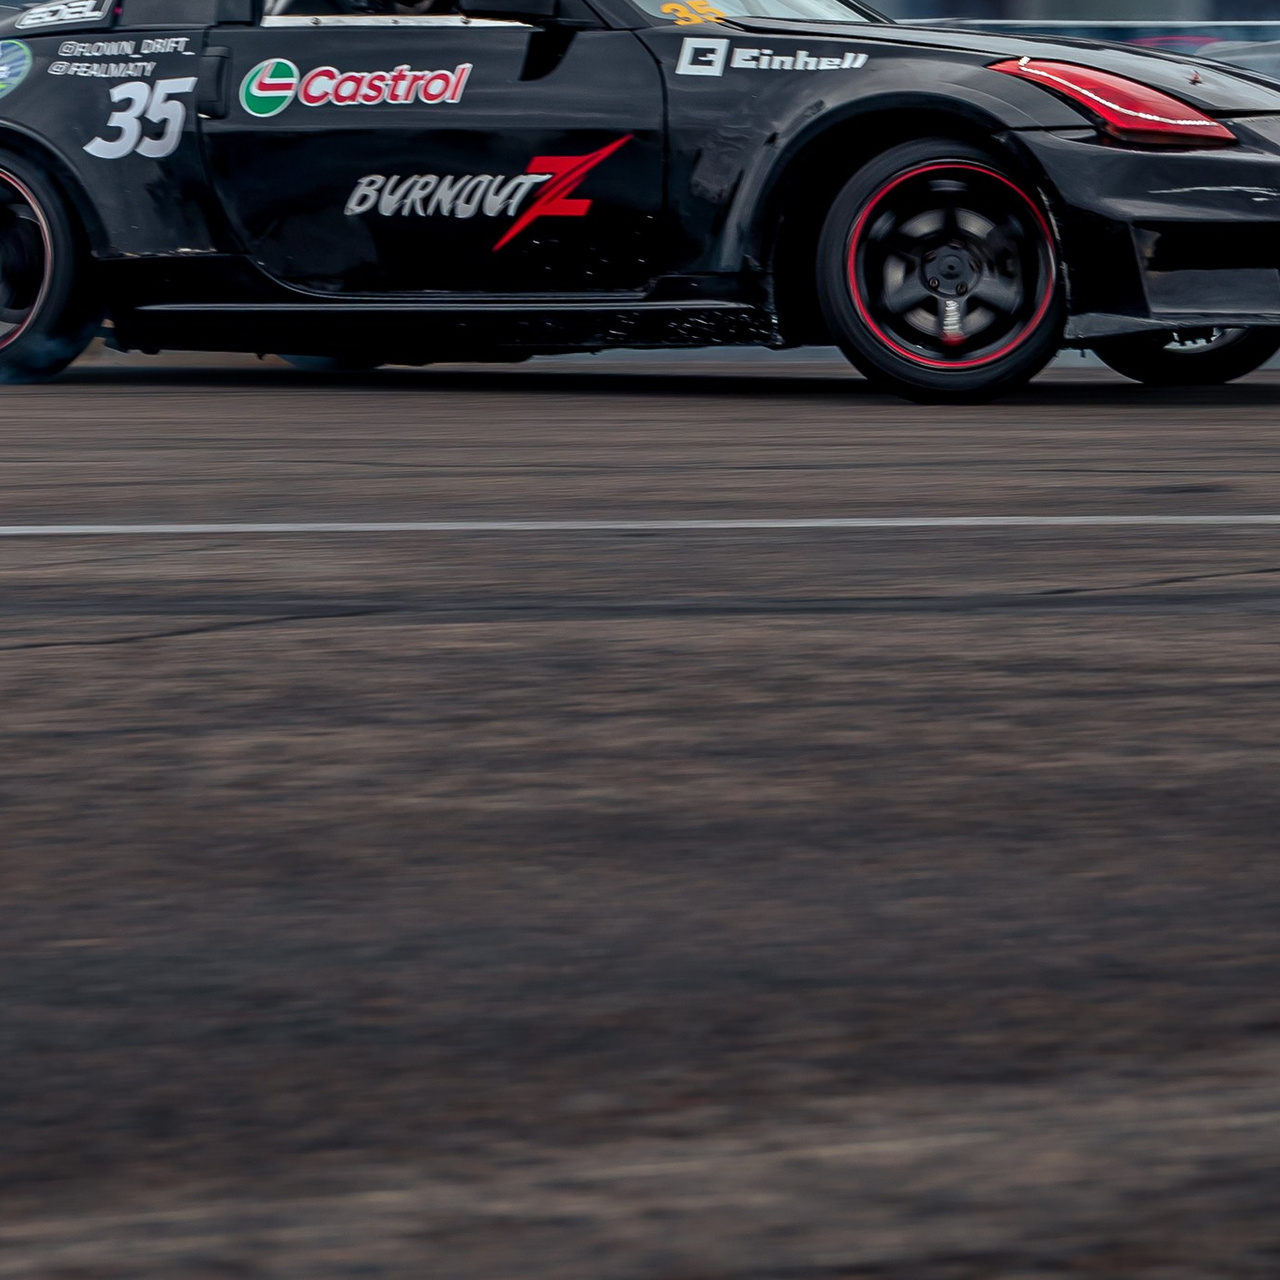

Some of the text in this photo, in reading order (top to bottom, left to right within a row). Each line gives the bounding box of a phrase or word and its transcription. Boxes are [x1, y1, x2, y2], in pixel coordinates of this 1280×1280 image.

[660, 0, 726, 26] 35
[730, 48, 868, 71] Einhell
[298, 62, 474, 107] Castrol
[82, 76, 198, 160] 35
